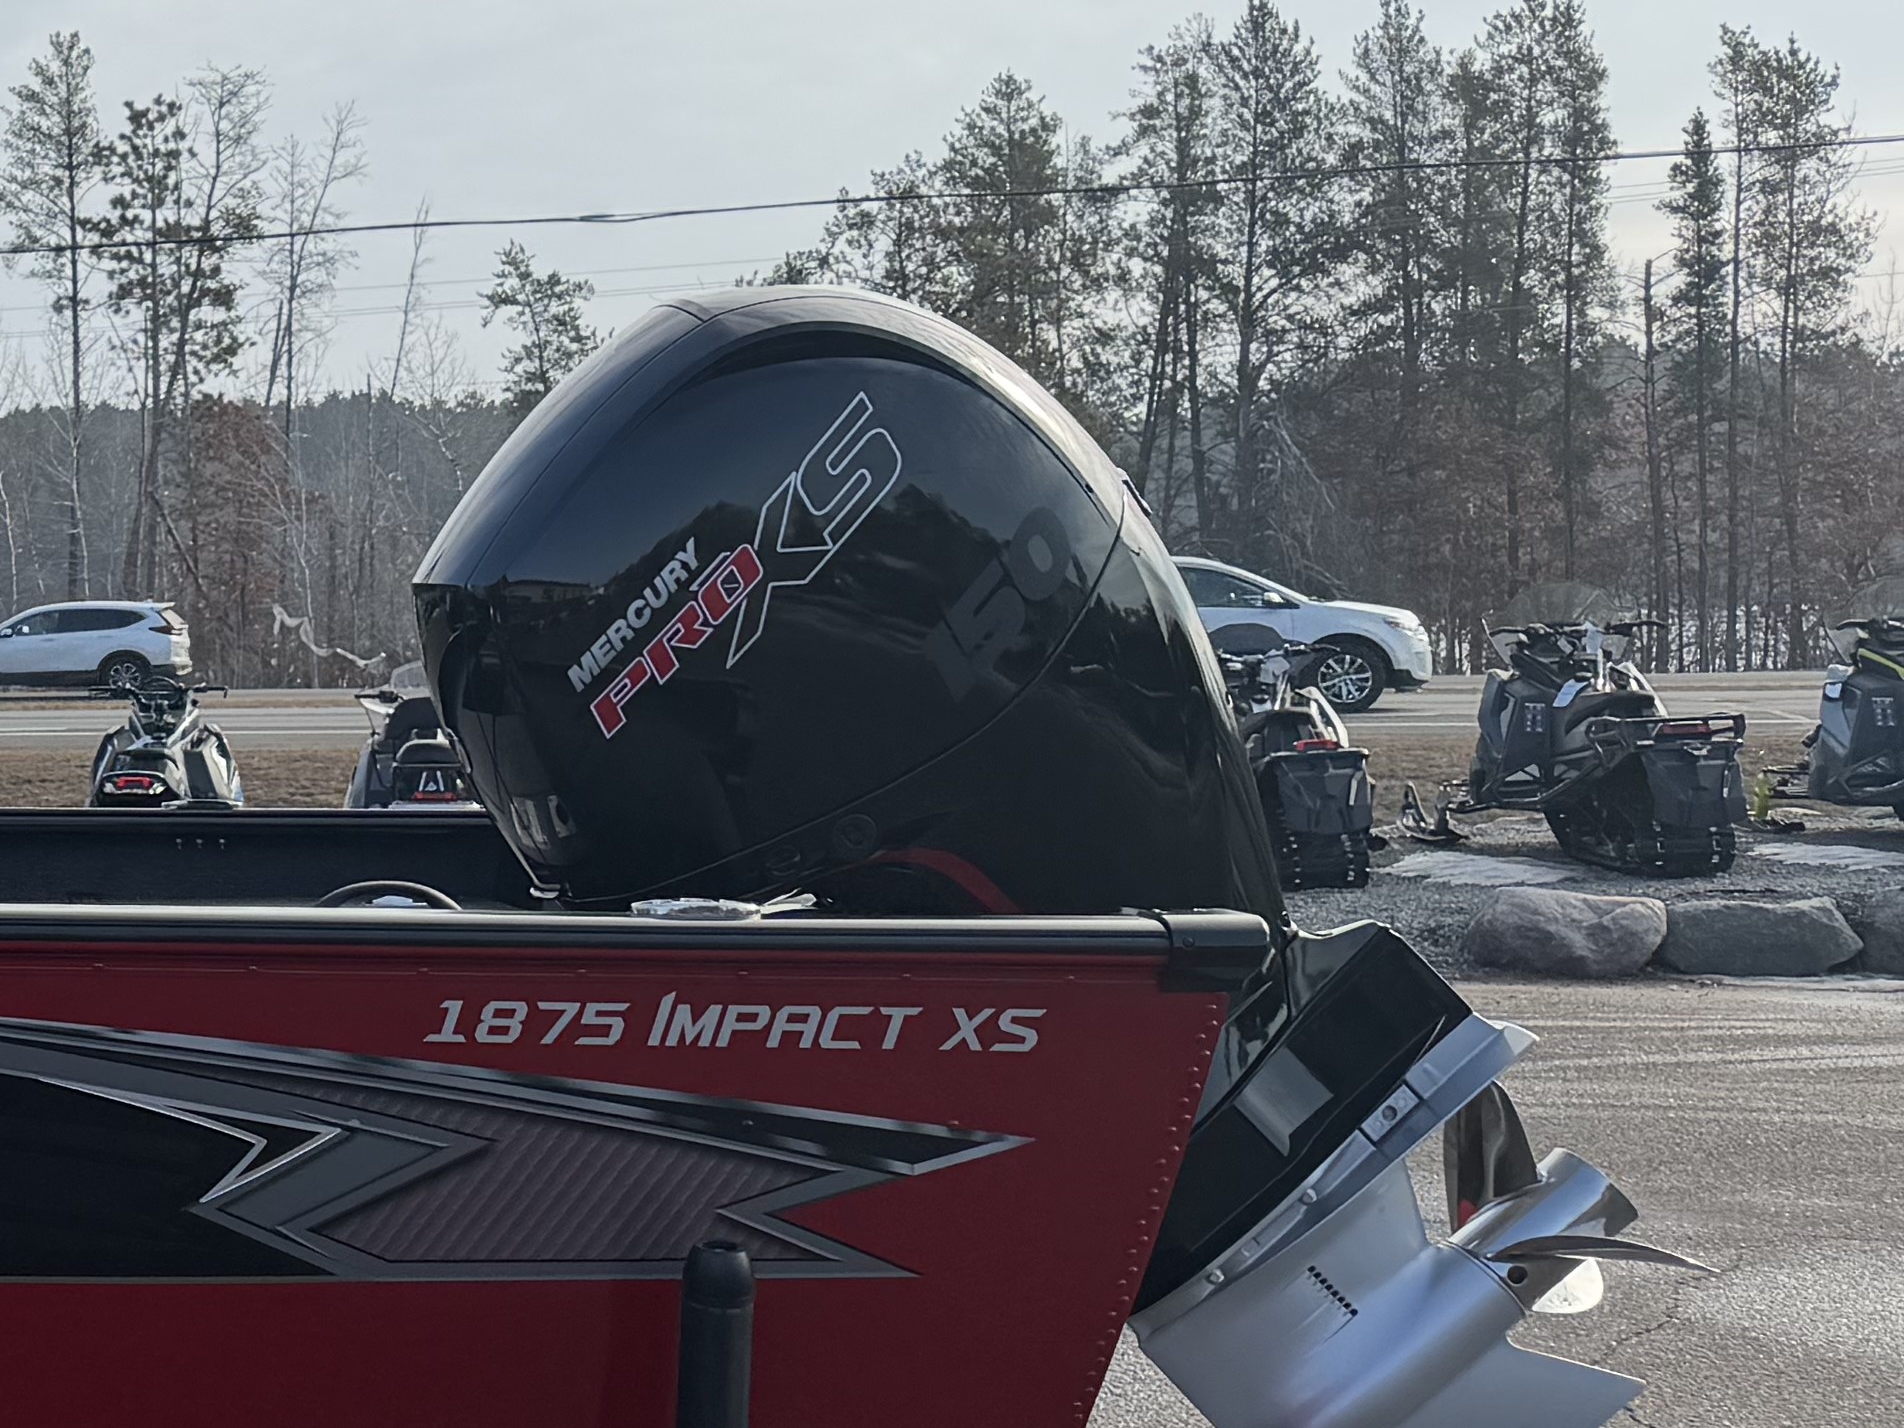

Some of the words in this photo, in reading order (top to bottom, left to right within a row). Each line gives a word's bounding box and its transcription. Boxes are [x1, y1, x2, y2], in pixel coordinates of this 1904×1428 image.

[567, 536, 700, 693] MERCURY
[590, 543, 764, 740] PRO
[423, 999, 630, 1044] 1875
[939, 1008, 1047, 1052] XS
